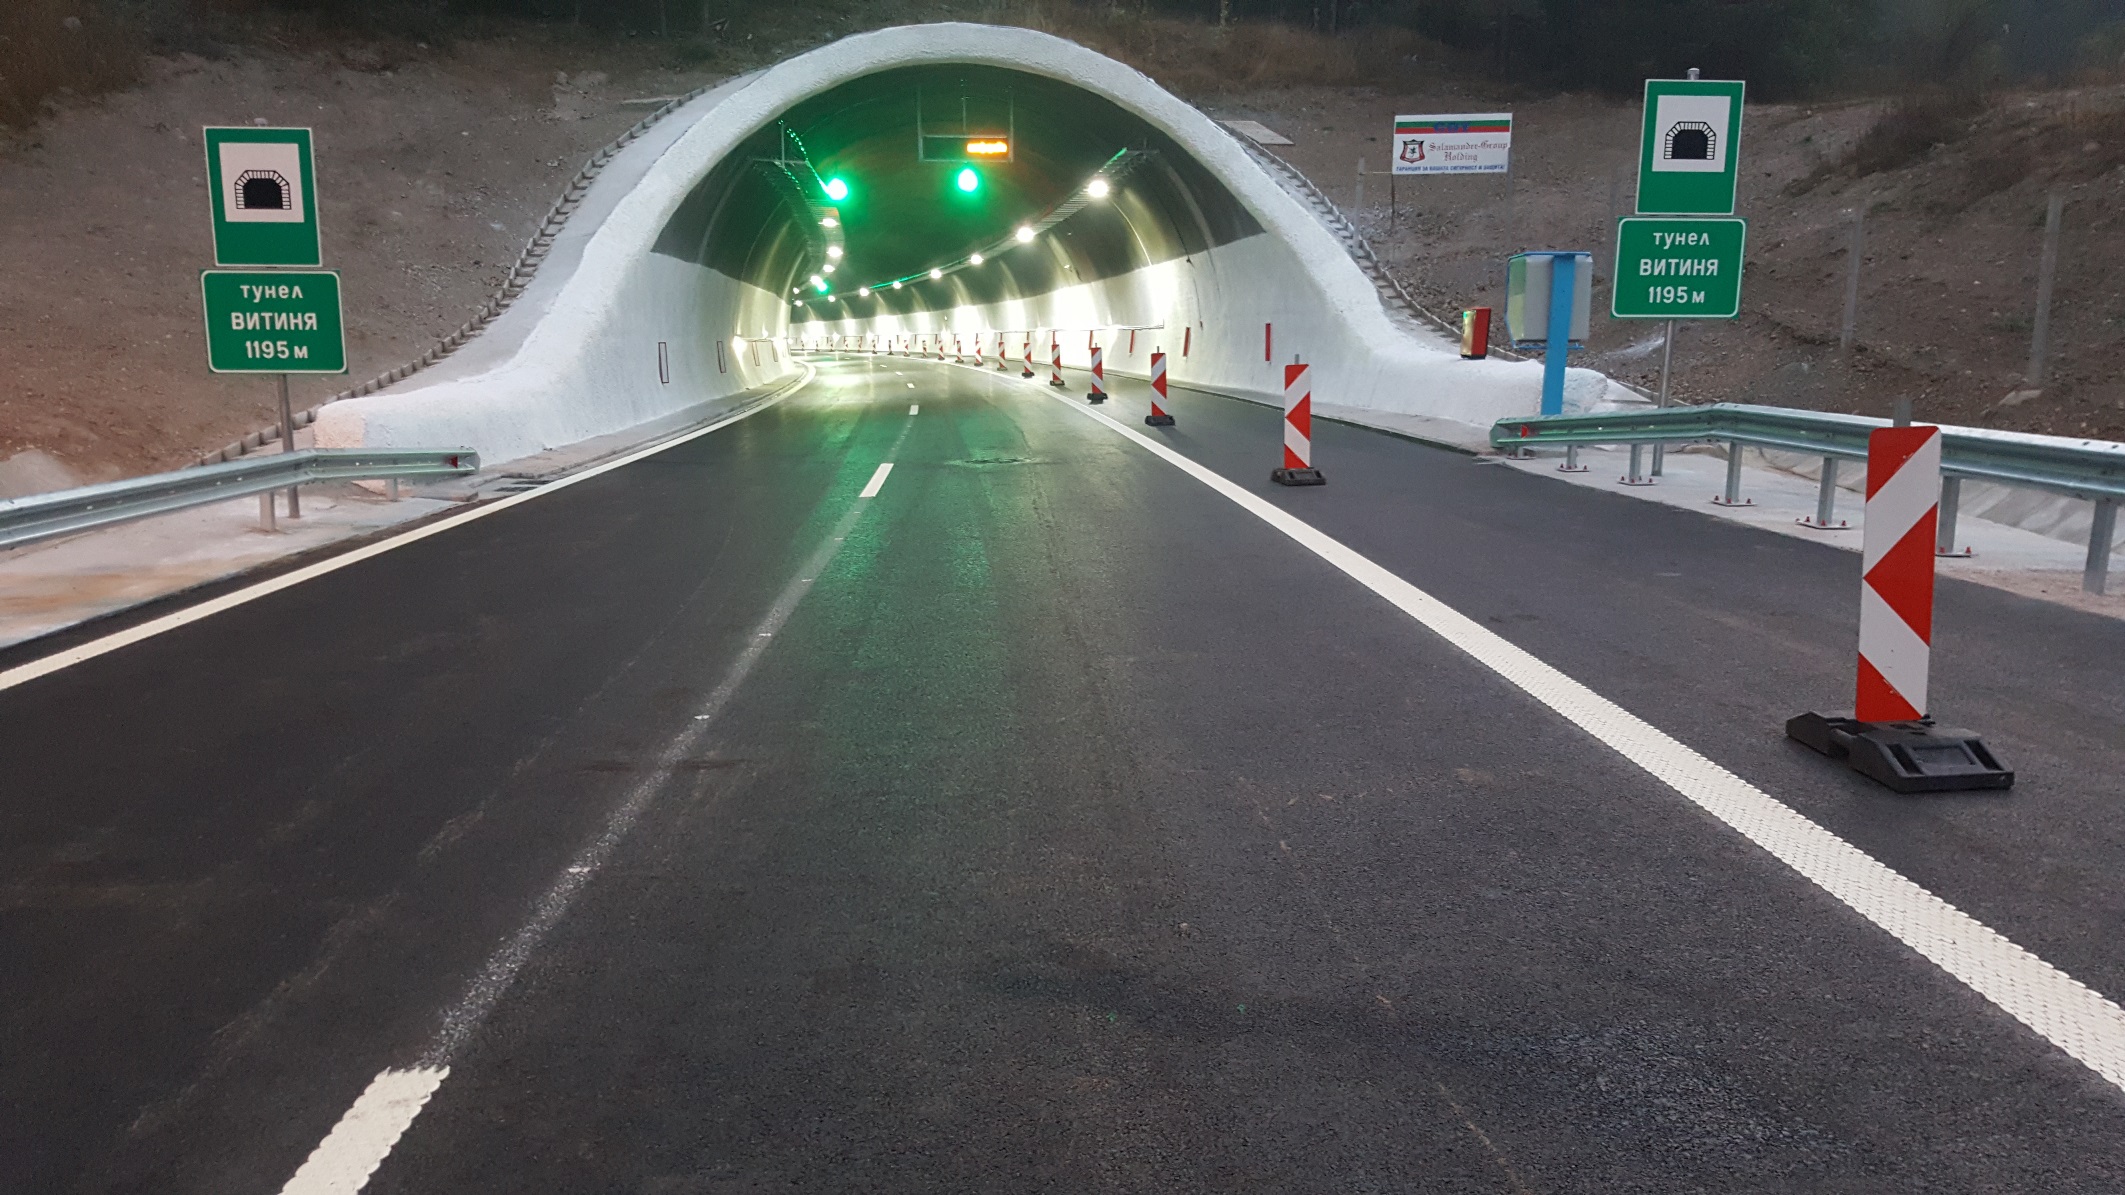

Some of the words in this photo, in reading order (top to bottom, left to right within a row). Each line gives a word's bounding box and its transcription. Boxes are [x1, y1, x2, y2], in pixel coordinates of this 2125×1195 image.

[1428, 140, 1508, 152] Salamander-Group
[1444, 151, 1478, 163] Holding
[1653, 232, 1710, 250] тунел
[1639, 258, 1719, 276] ВИТИНЯ
[240, 284, 303, 303] тунел
[1648, 286, 1688, 304] 1195
[1691, 291, 1705, 304] м
[230, 312, 318, 331] ВИТИНЯ
[245, 340, 290, 359] 1195
[293, 345, 309, 359] м
